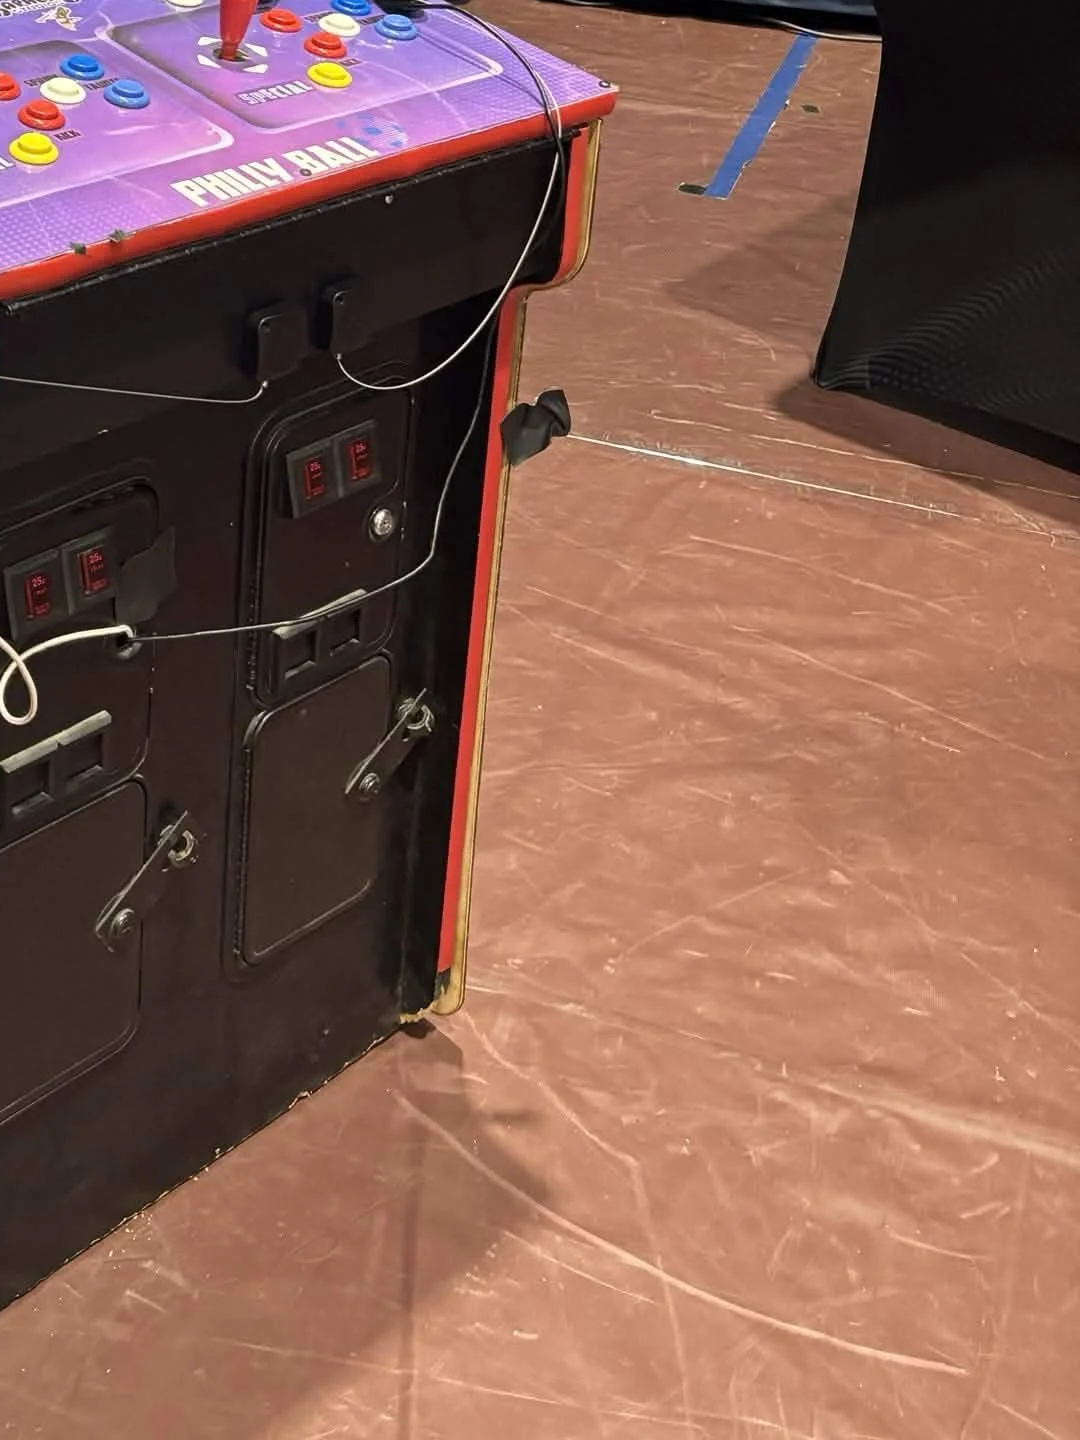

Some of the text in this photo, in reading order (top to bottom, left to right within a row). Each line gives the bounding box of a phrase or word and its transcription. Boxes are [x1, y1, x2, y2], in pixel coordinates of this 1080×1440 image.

[238, 79, 314, 105] SPECIAL
[170, 136, 382, 208] PHILLY BALL
